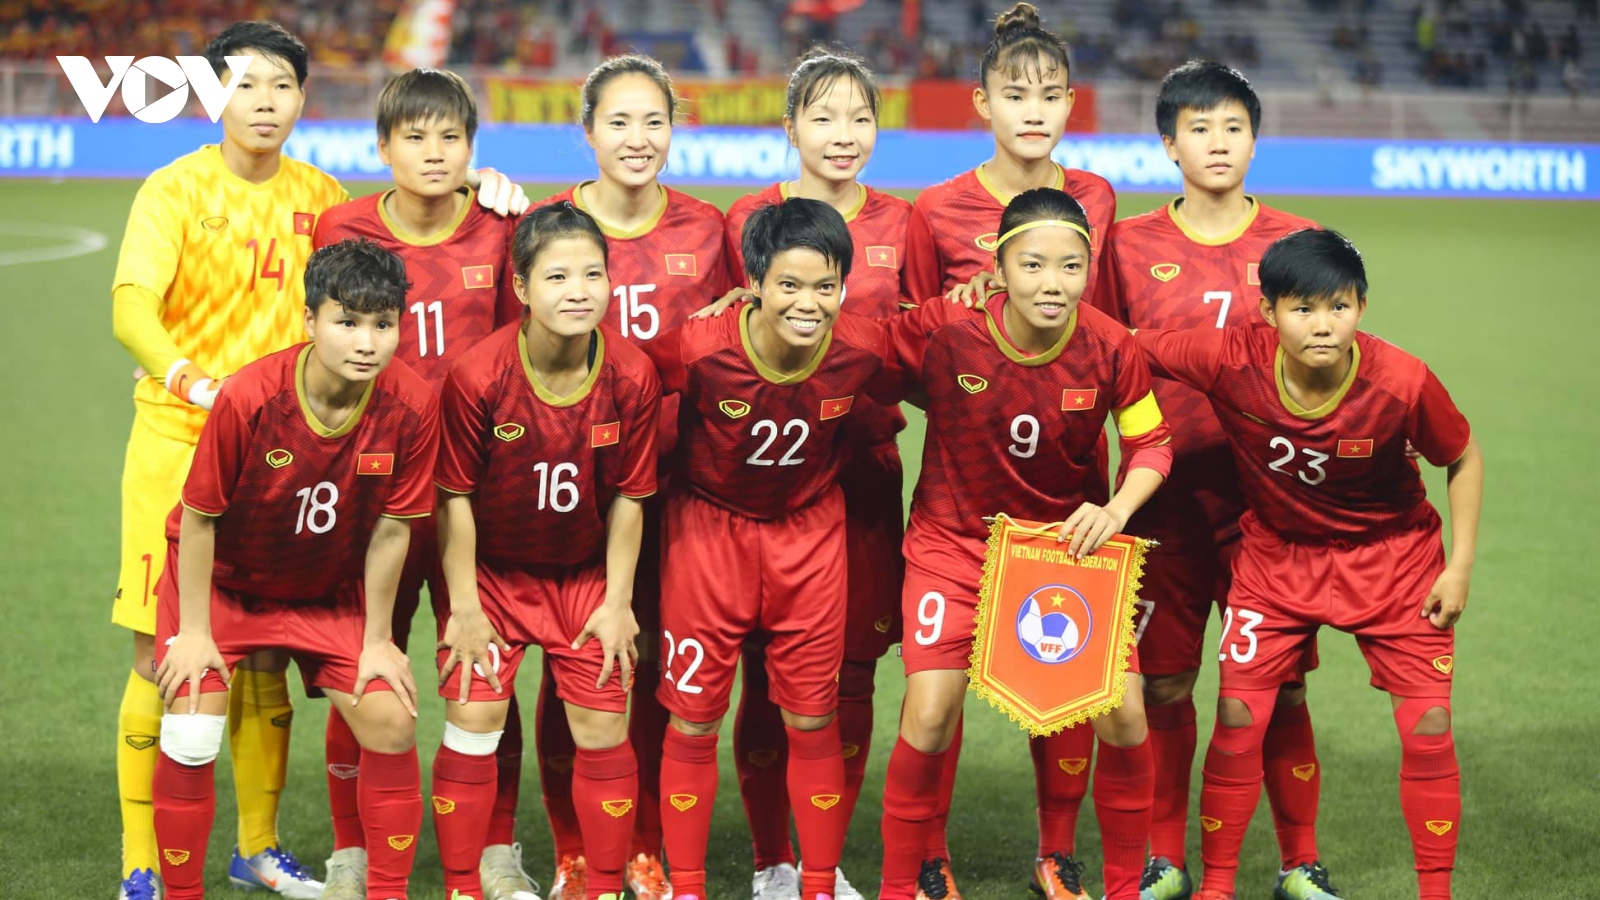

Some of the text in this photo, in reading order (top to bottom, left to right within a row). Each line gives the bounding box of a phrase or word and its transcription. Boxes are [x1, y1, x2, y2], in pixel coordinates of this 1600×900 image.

[1372, 145, 1587, 192] SKYWORTH
[246, 238, 285, 292] 14
[409, 300, 445, 357] 11
[613, 284, 660, 340] 15
[1203, 290, 1232, 329] 7
[746, 418, 810, 466] 22
[1008, 413, 1040, 459] 9
[1268, 436, 1330, 486] 23
[294, 481, 339, 535] 18
[533, 461, 580, 513] 16
[1011, 543, 1041, 561] VIETNAM
[141, 554, 159, 607] 1
[914, 591, 946, 646] 9
[1040, 642, 1063, 654] VFF
